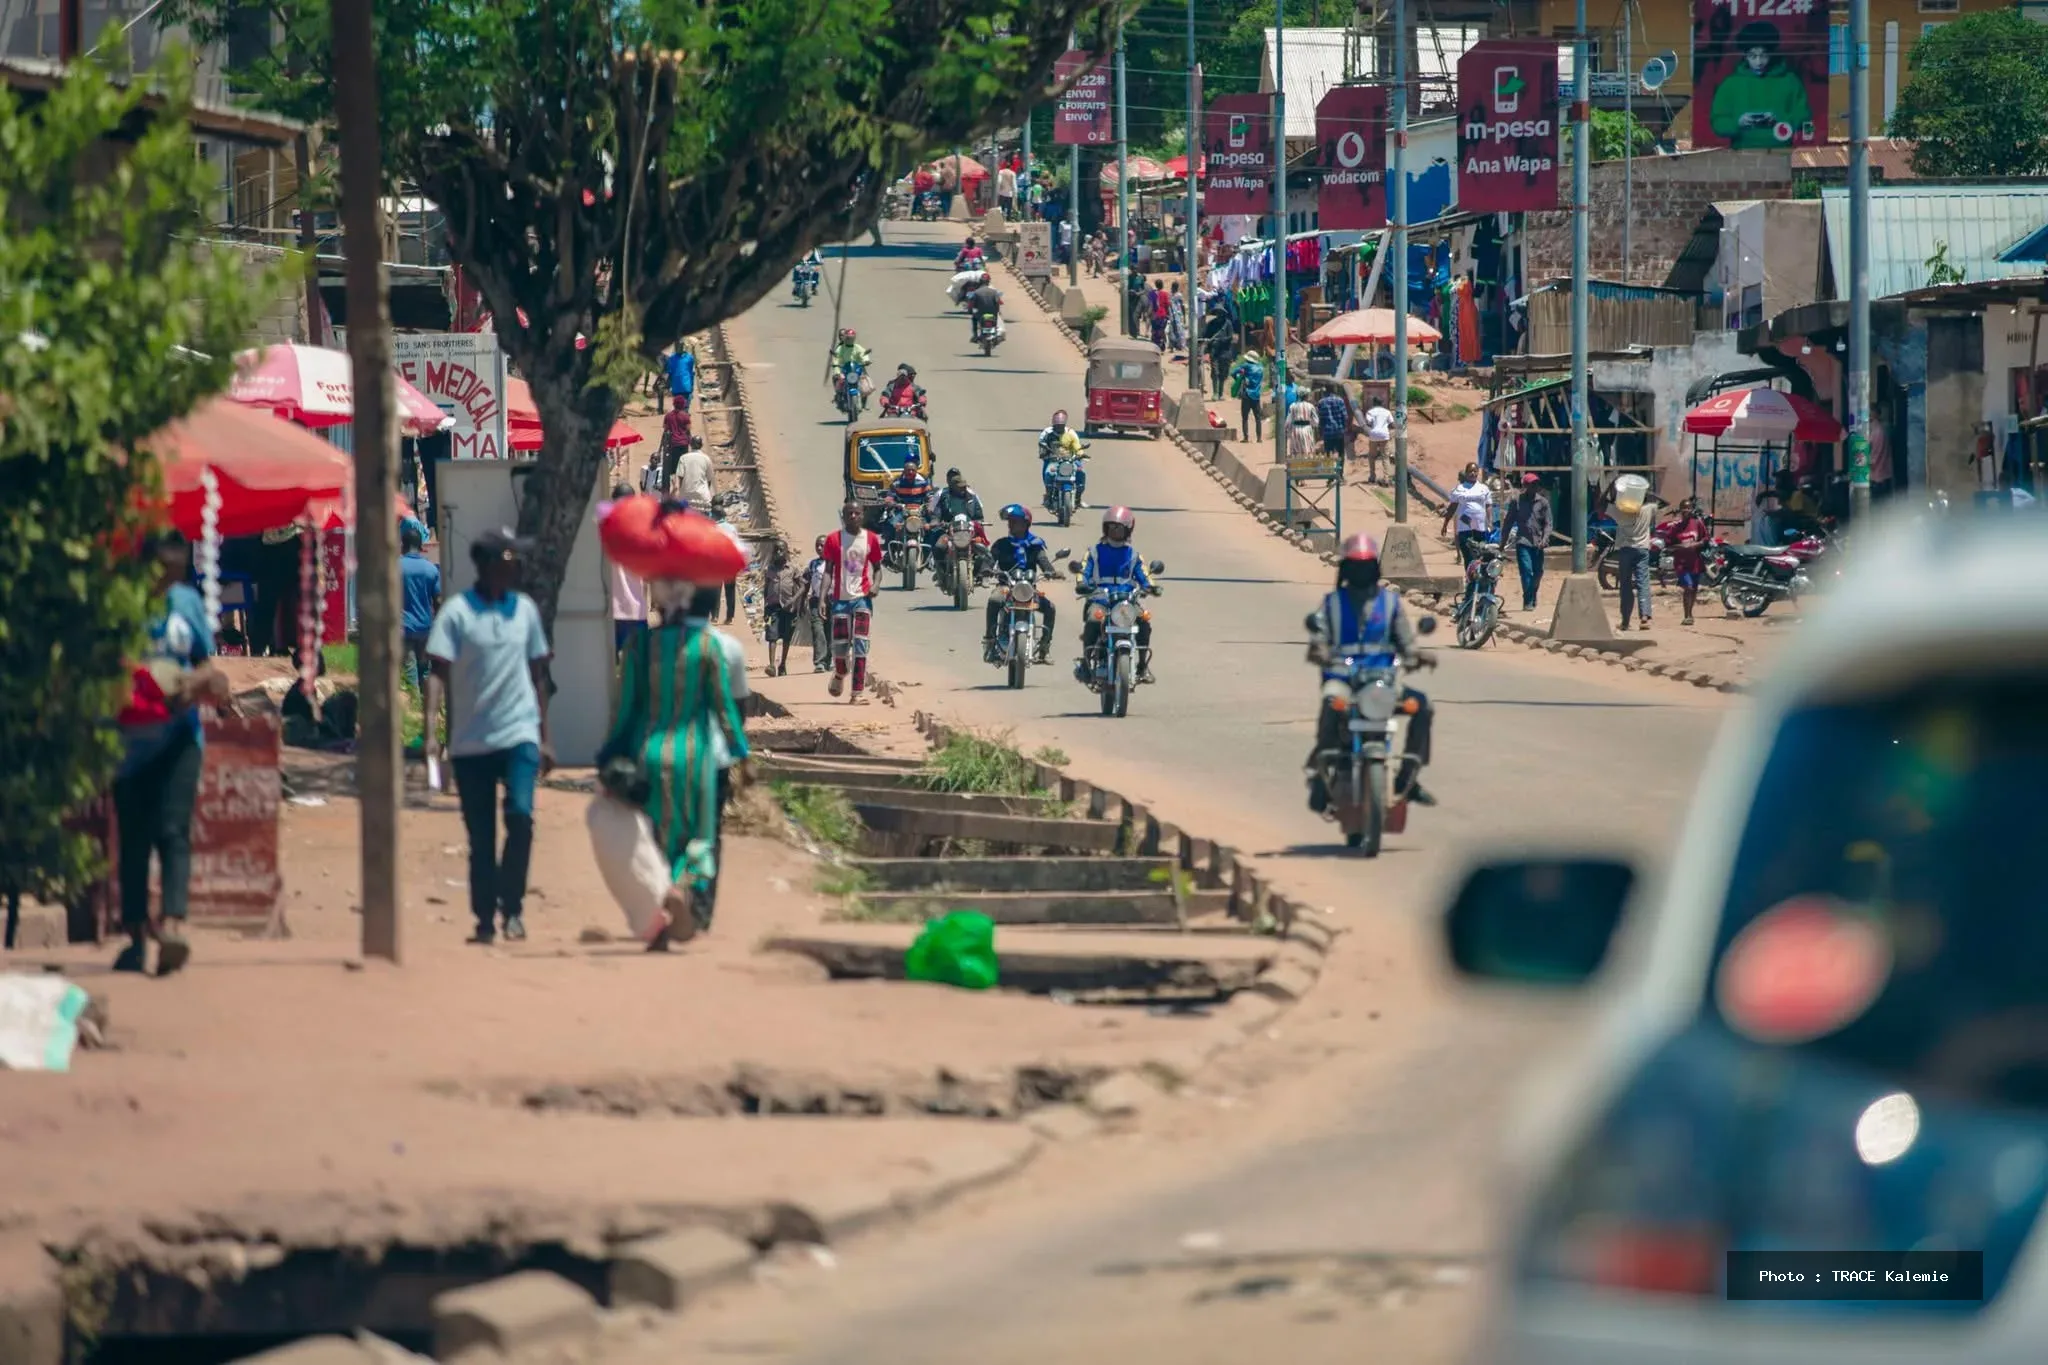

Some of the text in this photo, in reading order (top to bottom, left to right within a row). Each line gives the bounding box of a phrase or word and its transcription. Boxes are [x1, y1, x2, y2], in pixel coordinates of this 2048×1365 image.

[1064, 112, 1093, 121] ENVOI
[1465, 119, 1550, 144] m-pesa
[1210, 152, 1264, 168] m-pesa
[1465, 155, 1552, 176] Ana Wapa
[1210, 176, 1264, 191] Ana Wapa
[1322, 170, 1380, 185] vodacom
[426, 360, 500, 432] MEDICAL
[452, 432, 498, 459] MA
